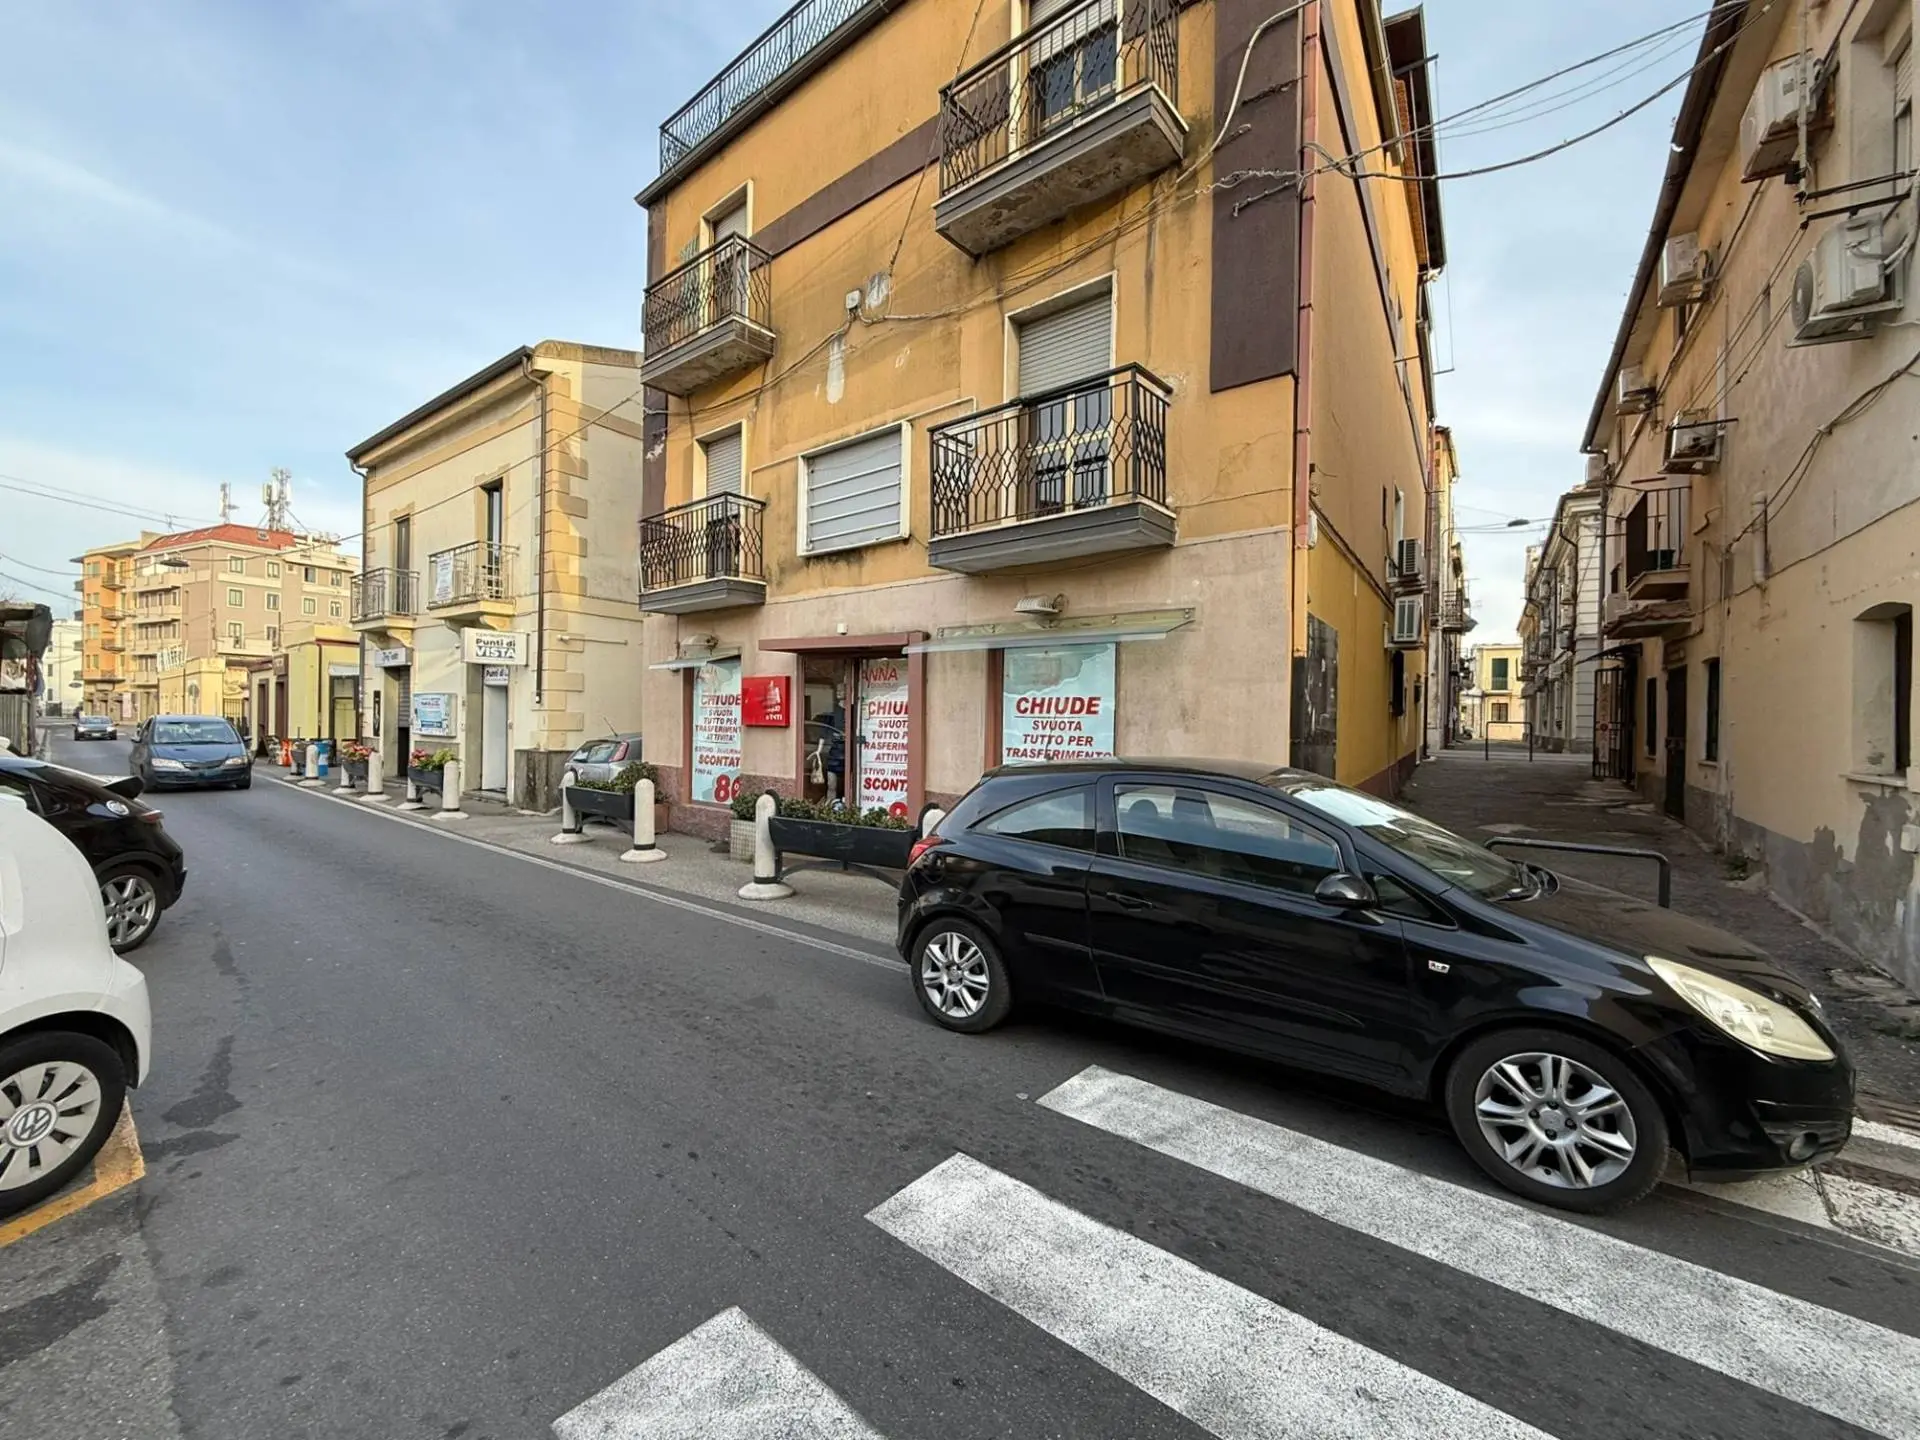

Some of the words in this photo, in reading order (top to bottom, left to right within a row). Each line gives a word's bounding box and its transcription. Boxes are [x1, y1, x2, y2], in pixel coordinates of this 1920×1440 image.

[476, 638, 504, 646] Punti
[476, 646, 516, 658] VISTA
[701, 694, 741, 706] CHIUDE
[1016, 696, 1101, 715] CHIUDE
[708, 709, 733, 717] SVUOTA
[878, 720, 909, 729] SVUOT
[1032, 720, 1082, 732] SVUOTA
[872, 731, 900, 740] TUTTO
[1023, 734, 1064, 746] TUTTO
[1067, 736, 1094, 747] PER
[864, 777, 909, 792] SCONT
